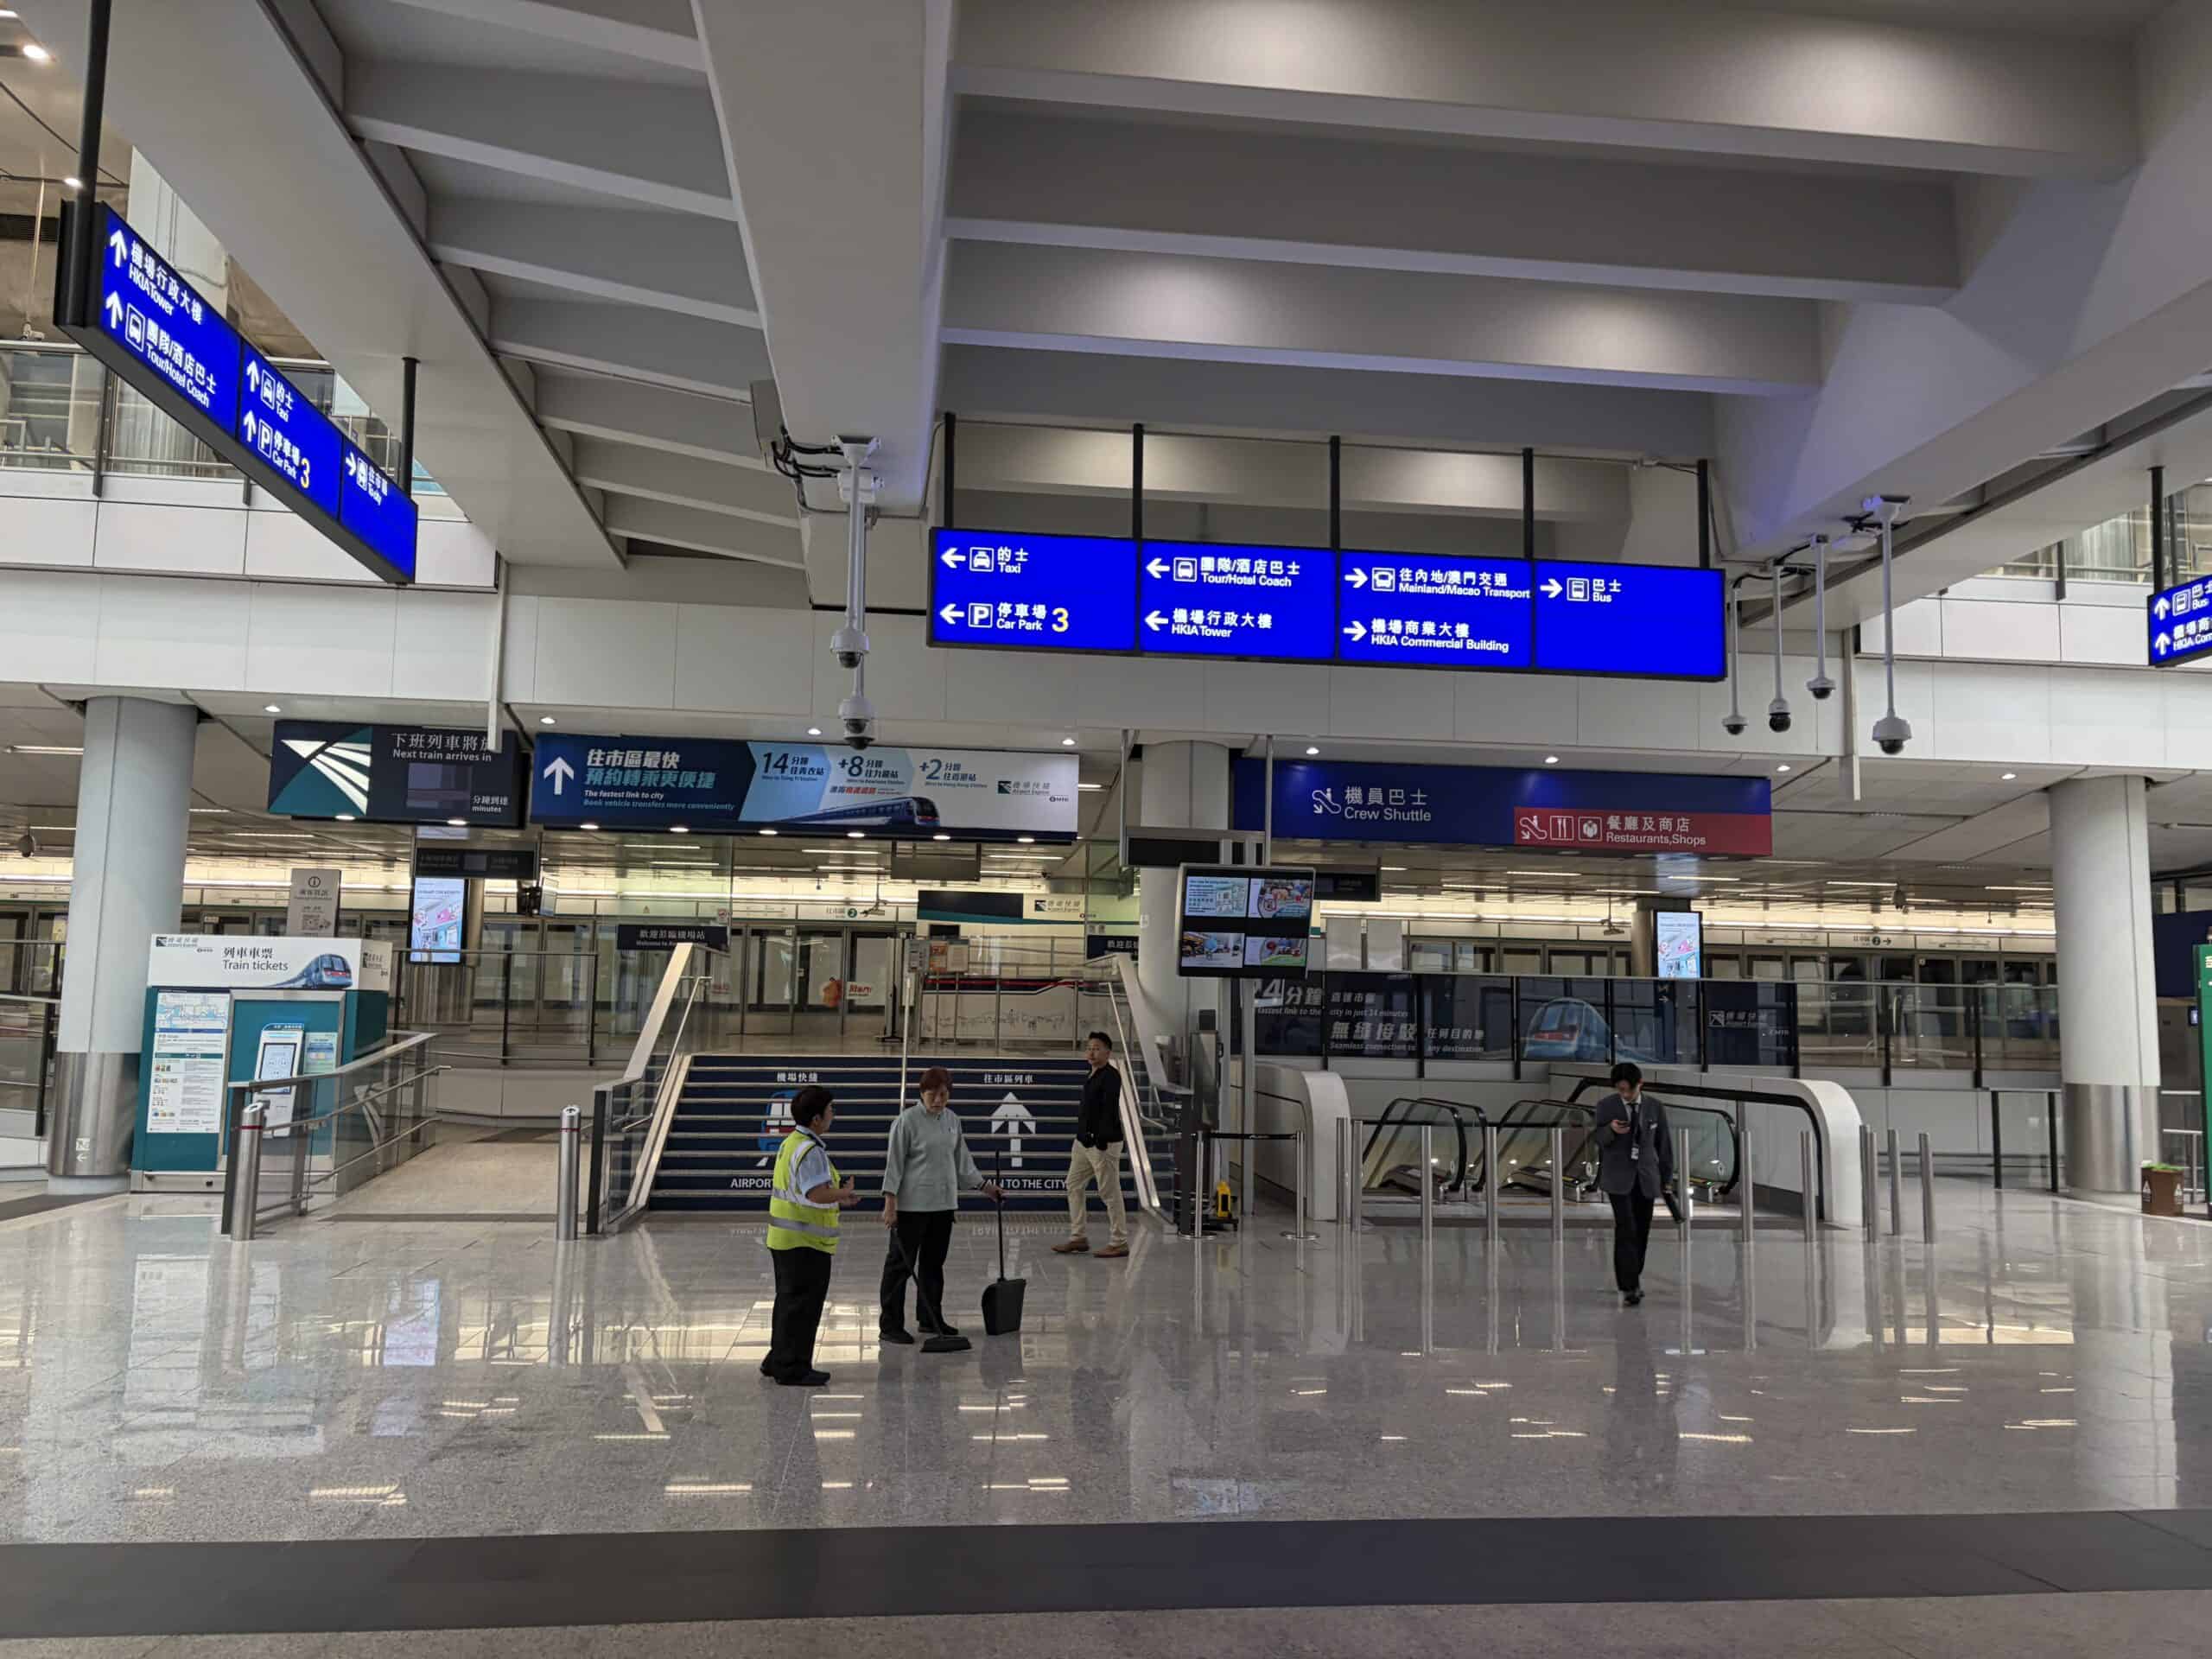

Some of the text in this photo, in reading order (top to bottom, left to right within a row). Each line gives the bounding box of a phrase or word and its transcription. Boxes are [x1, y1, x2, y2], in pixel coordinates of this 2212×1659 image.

[130, 262, 175, 316] HKIA Tower
[131, 240, 202, 325] 機場行政大樓
[147, 318, 217, 395] 團隊/酒店巴士
[146, 342, 210, 408] Tour/Hotel Coach
[276, 381, 294, 410] 的士
[276, 400, 289, 422] Taxi
[261, 425, 270, 449] P
[274, 430, 300, 467] 停車場
[272, 449, 296, 480] Car Park
[301, 457, 310, 489] 3
[997, 547, 1029, 563] 的士
[998, 563, 1021, 574] Taxi
[1200, 558, 1300, 576] 團隊/酒店巴士
[1202, 574, 1292, 588] Tour/Hotel Coach
[1592, 579, 1621, 593] 巴士
[1398, 583, 1530, 600] Mainland/Macao Transport
[1592, 592, 1611, 603] Bus
[997, 602, 1047, 620] 停車場
[2192, 598, 2209, 610] Bus
[973, 607, 989, 626] P
[996, 619, 1043, 632] Car Park
[1052, 608, 1069, 632] 3
[1173, 608, 1273, 630] 機場行政大樓
[1172, 624, 1232, 638] HKIA Tower
[1371, 619, 1470, 638] 機場商業大樓
[2173, 617, 2212, 640] 機場商
[1371, 634, 1510, 653] HKIA Commercial Building
[393, 748, 492, 762] Next train arrives in
[587, 748, 681, 769] 往市區最快
[762, 752, 789, 774] 14
[838, 755, 864, 777] +8
[919, 759, 942, 780] +2
[584, 789, 596, 798] The
[599, 790, 624, 798] fastest
[651, 791, 664, 801] city
[1344, 785, 1428, 806] 機員巴士
[472, 804, 502, 813] minutes
[1344, 806, 1432, 822] Crew Shuttle
[1606, 816, 1690, 832] 餐廳及商店
[223, 959, 289, 971] Train tickets
[730, 1178, 774, 1189] AIRPOR
[1006, 1179, 1020, 1189] TO
[1021, 1179, 1043, 1189] THE
[1044, 1179, 1066, 1190] CITY
